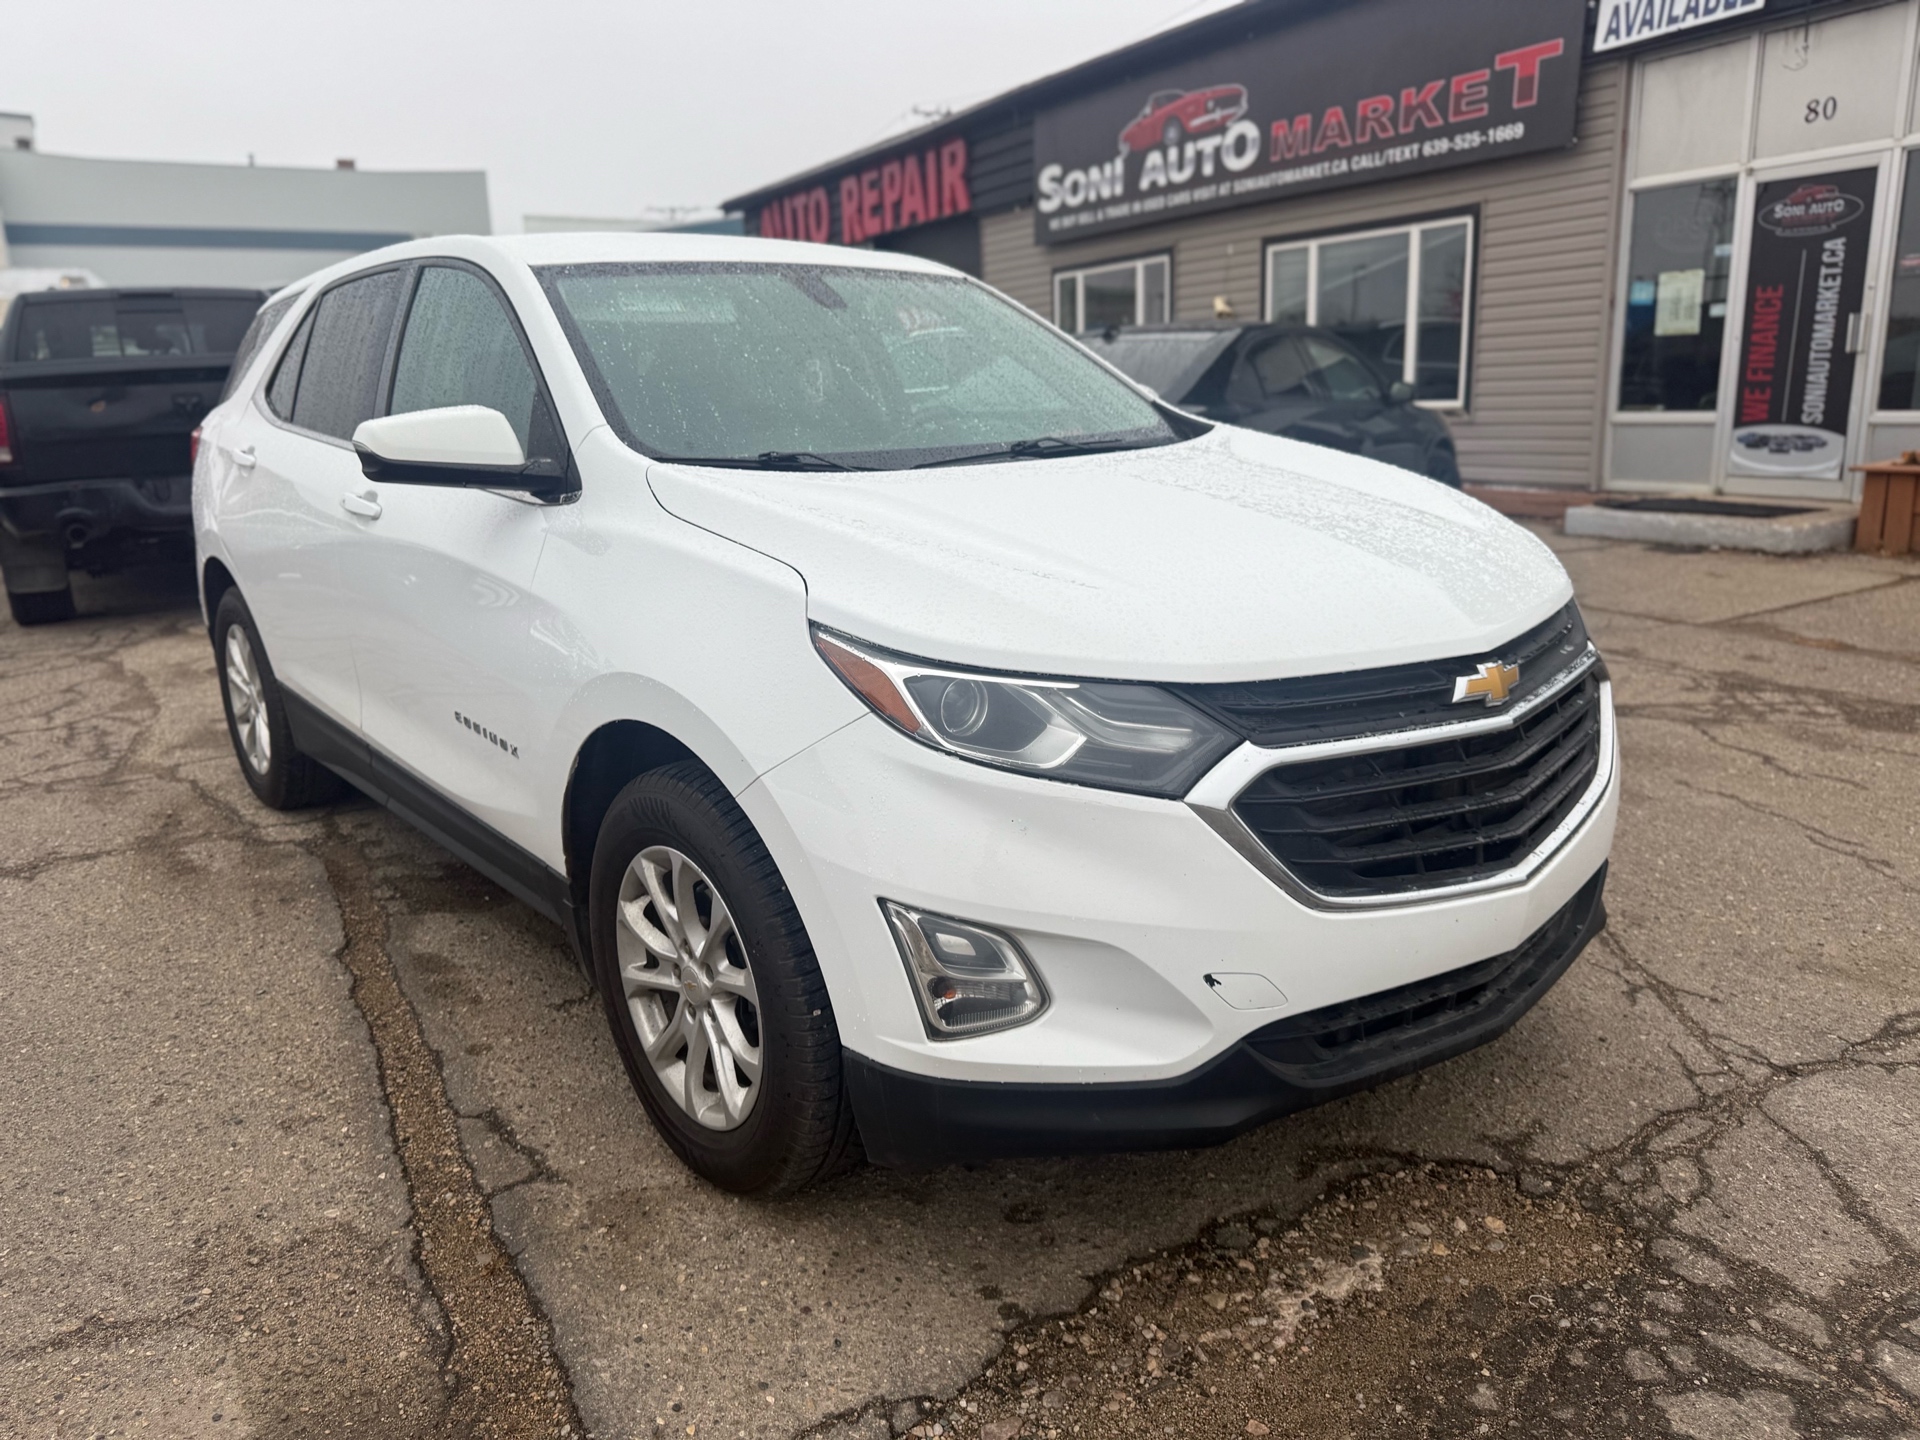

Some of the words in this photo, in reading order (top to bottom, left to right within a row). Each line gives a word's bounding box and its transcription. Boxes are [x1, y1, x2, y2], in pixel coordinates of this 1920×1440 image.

[1603, 0, 1758, 44] AVAILA
[1139, 119, 1260, 192] AUTO
[1270, 38, 1564, 163] MARKET
[1804, 96, 1838, 124] 80
[760, 186, 830, 244] AUTO
[839, 138, 972, 244] REPAIR
[1232, 158, 1349, 194] SONIAUTOMARKET.CA
[1350, 142, 1421, 172] CALL/TEXT
[1421, 121, 1525, 158] 639-525-1669
[1746, 284, 1784, 381] FINANCE
[1801, 236, 1847, 425] SONIAUTOMARKET.CA
[1740, 386, 1772, 422] WE
